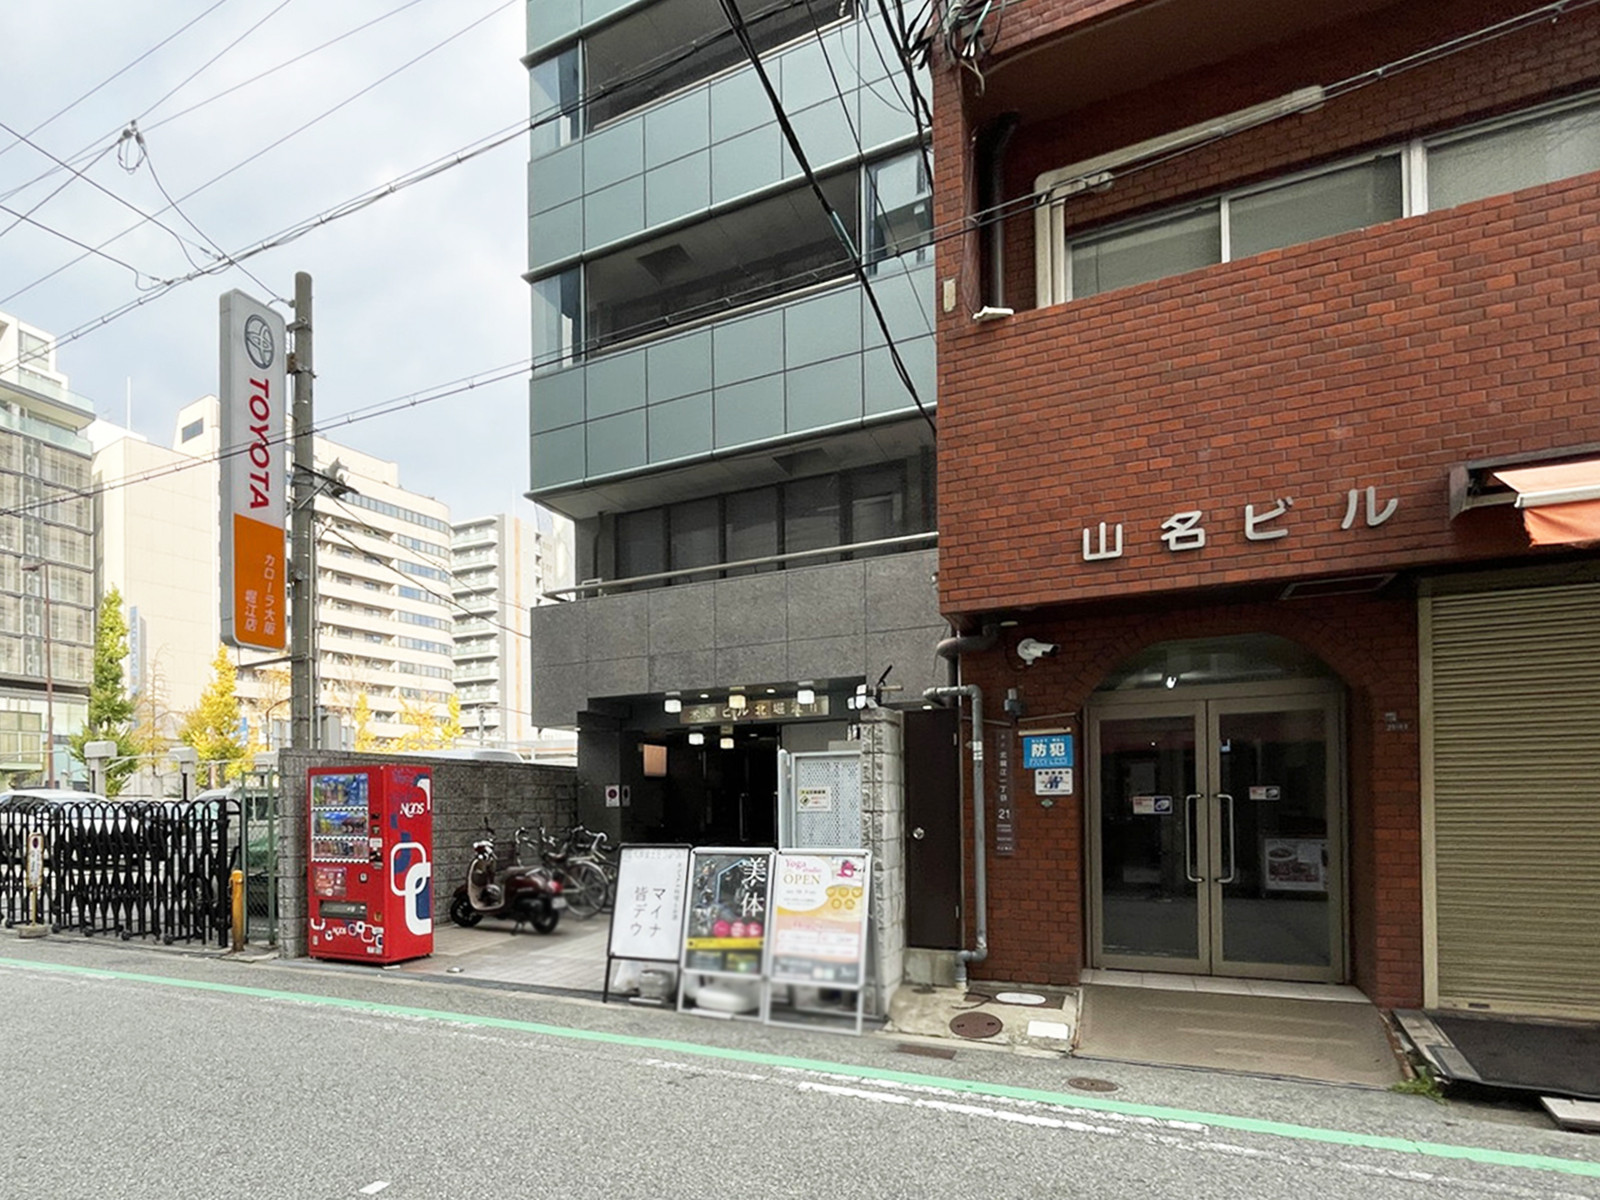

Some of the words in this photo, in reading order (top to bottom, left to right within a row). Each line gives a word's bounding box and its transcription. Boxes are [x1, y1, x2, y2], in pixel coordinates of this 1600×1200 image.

[249, 377, 270, 509] TOYOTA
[1083, 486, 1398, 561] 山名ビル
[245, 589, 258, 632] 堀江店
[263, 554, 276, 635] カローラ大阪
[1031, 743, 1066, 757] 防犯
[998, 808, 1011, 819] 21
[783, 874, 821, 885] OPEN
